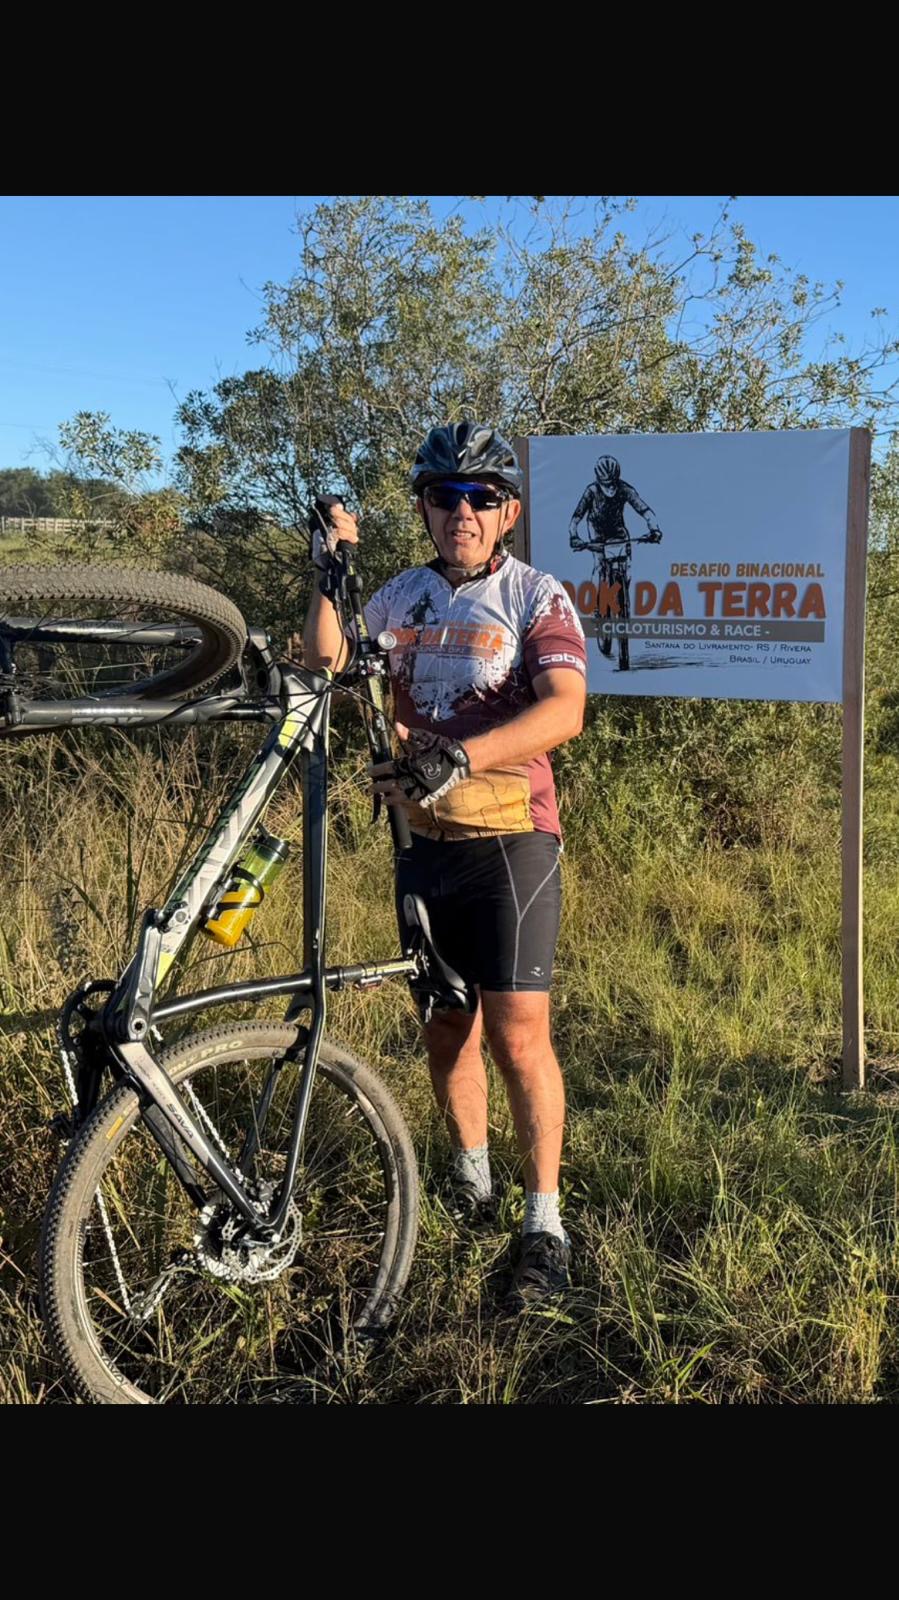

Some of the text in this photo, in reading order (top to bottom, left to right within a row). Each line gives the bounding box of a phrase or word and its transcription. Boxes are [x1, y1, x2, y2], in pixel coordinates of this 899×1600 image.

[670, 563, 824, 577] DESAFIO BINACIONAL
[634, 581, 684, 617] DA
[698, 581, 826, 619] TERRA
[602, 623, 706, 636] CICLOTURISMO
[710, 624, 720, 636] &
[724, 625, 761, 636] RACE
[756, 643, 770, 652] RS
[200, 1040, 243, 1058] PRO
[166, 1103, 194, 1139] SAVA
